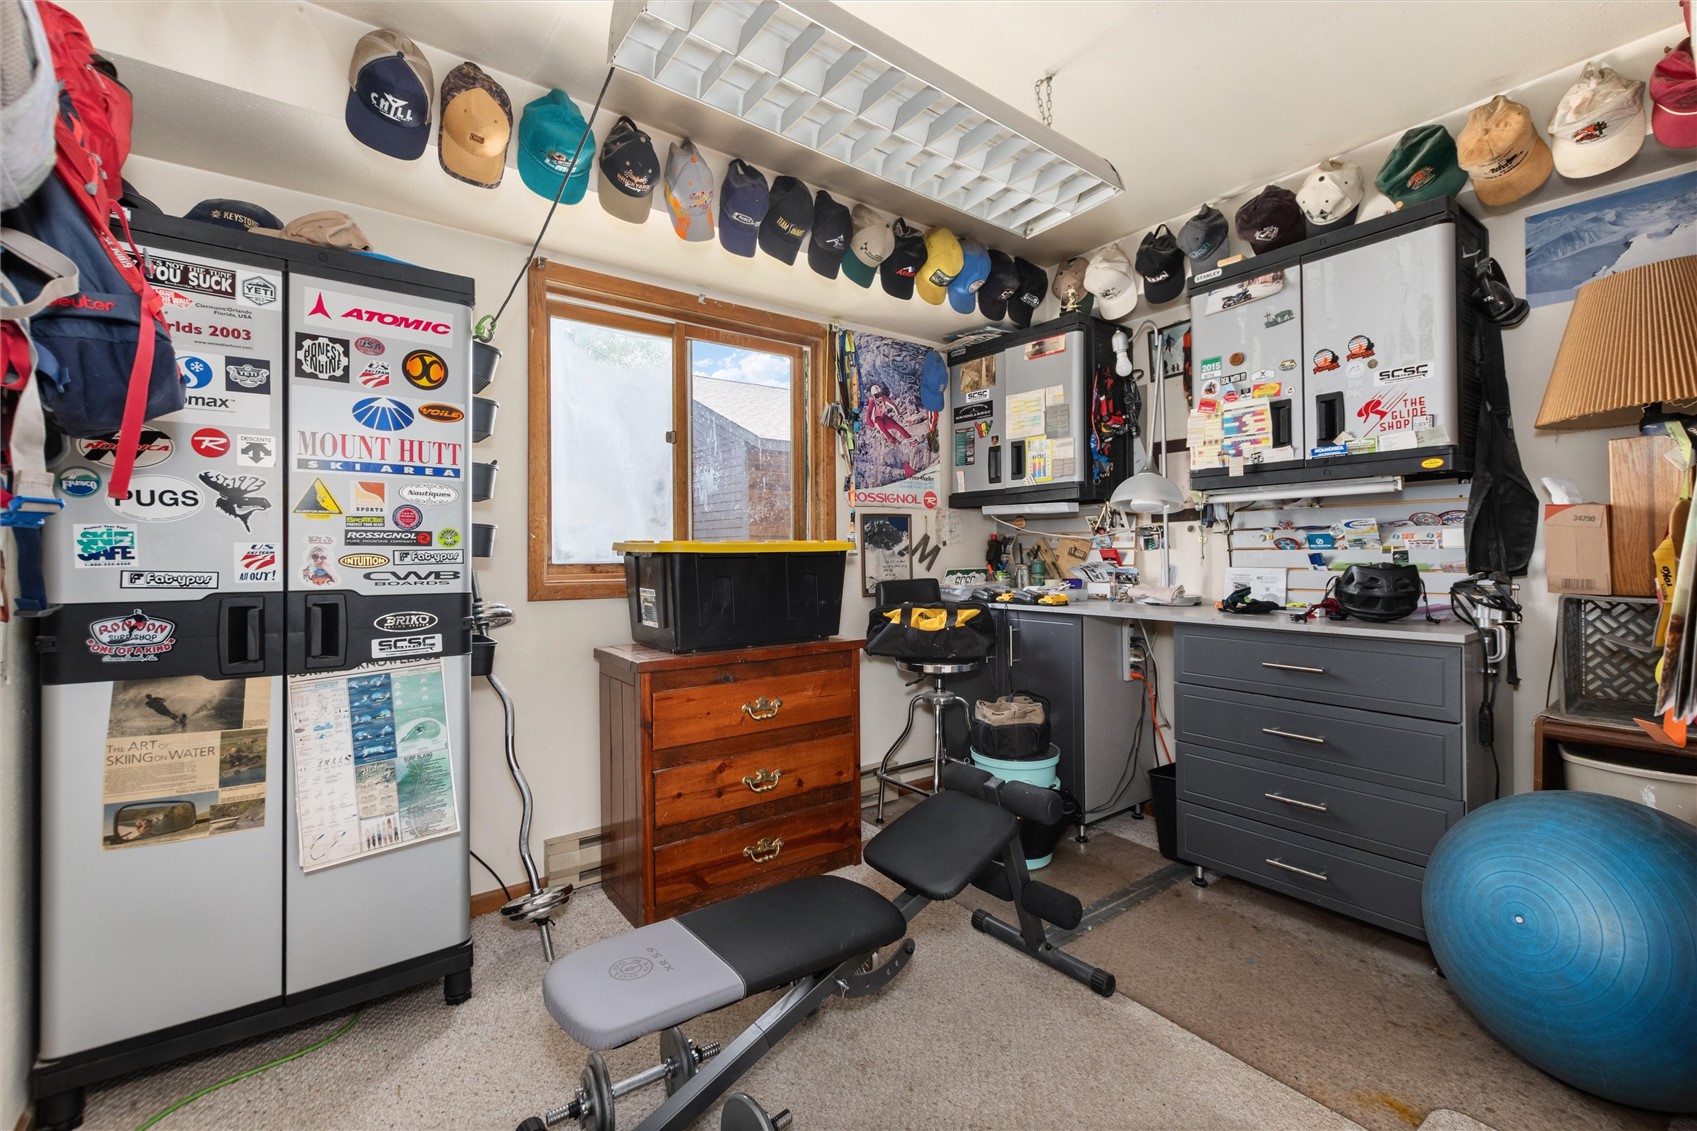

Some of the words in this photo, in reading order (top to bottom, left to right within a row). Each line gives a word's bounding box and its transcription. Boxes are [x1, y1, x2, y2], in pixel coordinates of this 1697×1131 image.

[166, 262, 185, 270] NOT
[188, 266, 206, 275] THE
[209, 270, 233, 279] TUNE
[1196, 271, 1221, 282] STANLEY
[188, 272, 233, 293] SUCK
[246, 286, 273, 297] YETI
[195, 302, 253, 314] Clermont/Orlando
[341, 308, 452, 335] ATOMIC
[208, 325, 252, 340] 2003
[304, 342, 342, 360] HONEST
[359, 339, 382, 350] USA
[305, 355, 342, 375] ENGINE
[1201, 362, 1221, 373] 2015
[1379, 364, 1428, 381] SCSC
[1403, 396, 1425, 409] THE
[1391, 406, 1427, 421] GLIDE
[1380, 420, 1410, 432] SHOP
[297, 431, 391, 462] MOUNT
[398, 438, 462, 466] HUTT
[408, 490, 451, 498] Nautiques
[77, 545, 135, 561] SAFE
[911, 533, 941, 573] M
[344, 557, 386, 566] INTUITION
[363, 570, 461, 580] CWB
[98, 620, 132, 635] RON
[135, 622, 168, 634] JON
[384, 615, 429, 627] BRIKO
[134, 633, 158, 642] SHOP
[378, 636, 436, 651] SCSC
[117, 646, 133, 655] OF
[135, 647, 143, 655] A
[107, 745, 125, 754] THE
[127, 739, 158, 752] ART
[106, 753, 154, 767] SKIING
[168, 746, 216, 760] WATER
